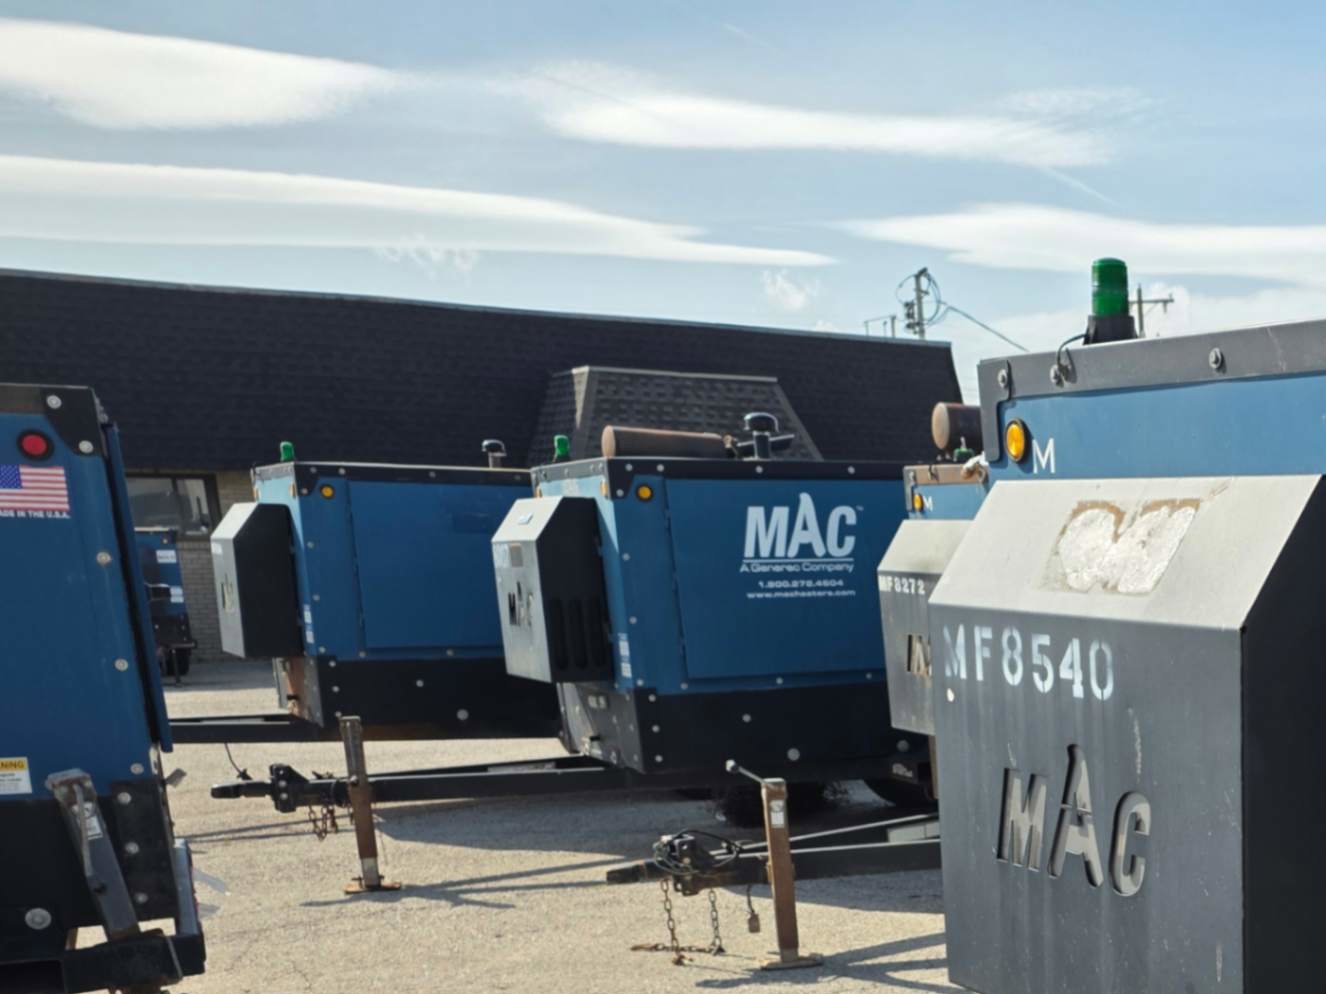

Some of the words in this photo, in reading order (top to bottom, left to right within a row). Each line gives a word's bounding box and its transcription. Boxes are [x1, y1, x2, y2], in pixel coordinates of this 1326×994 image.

[1032, 438, 1056, 474] M
[743, 491, 857, 558] MAC
[801, 561, 854, 574] Company
[942, 623, 1115, 701] MF8540
[995, 742, 1152, 898] MAC
